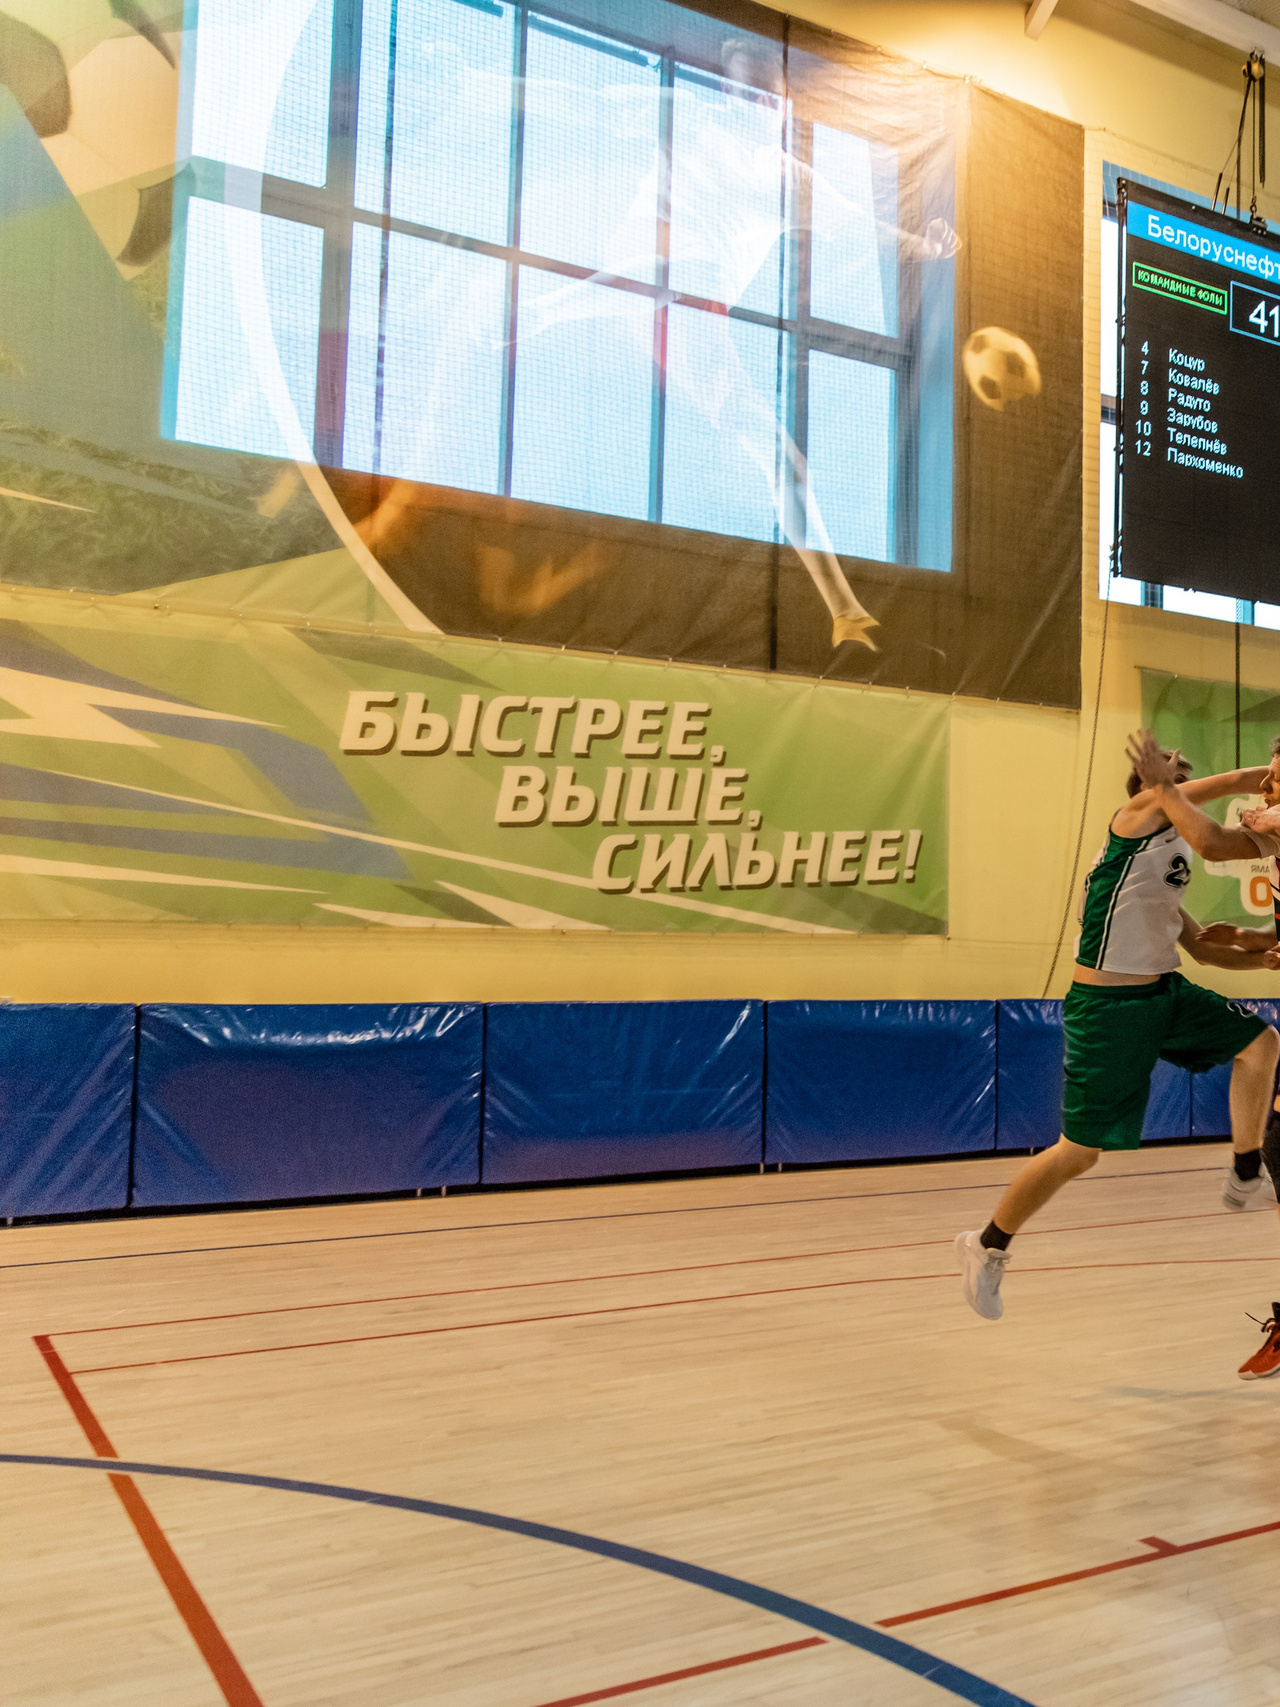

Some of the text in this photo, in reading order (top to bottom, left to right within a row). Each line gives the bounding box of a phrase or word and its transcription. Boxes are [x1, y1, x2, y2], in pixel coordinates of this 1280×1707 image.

[1137, 269, 1197, 298] КОМАНДНЫЕ
[1249, 300, 1280, 338] 41
[1141, 341, 1206, 372] 4 Коцур
[1140, 380, 1211, 412] 8 Радуто
[1141, 360, 1220, 396] 7 Ковалёв
[1135, 419, 1152, 437] 10
[1140, 400, 1218, 434] 9 Зарубов
[1135, 439, 1244, 479] 12 Пархоменко
[338, 690, 726, 767] БЫСТРЕЕ,
[494, 765, 762, 831] ВЫШЕ,
[592, 829, 923, 895] СИЛЬНЕЕ!
